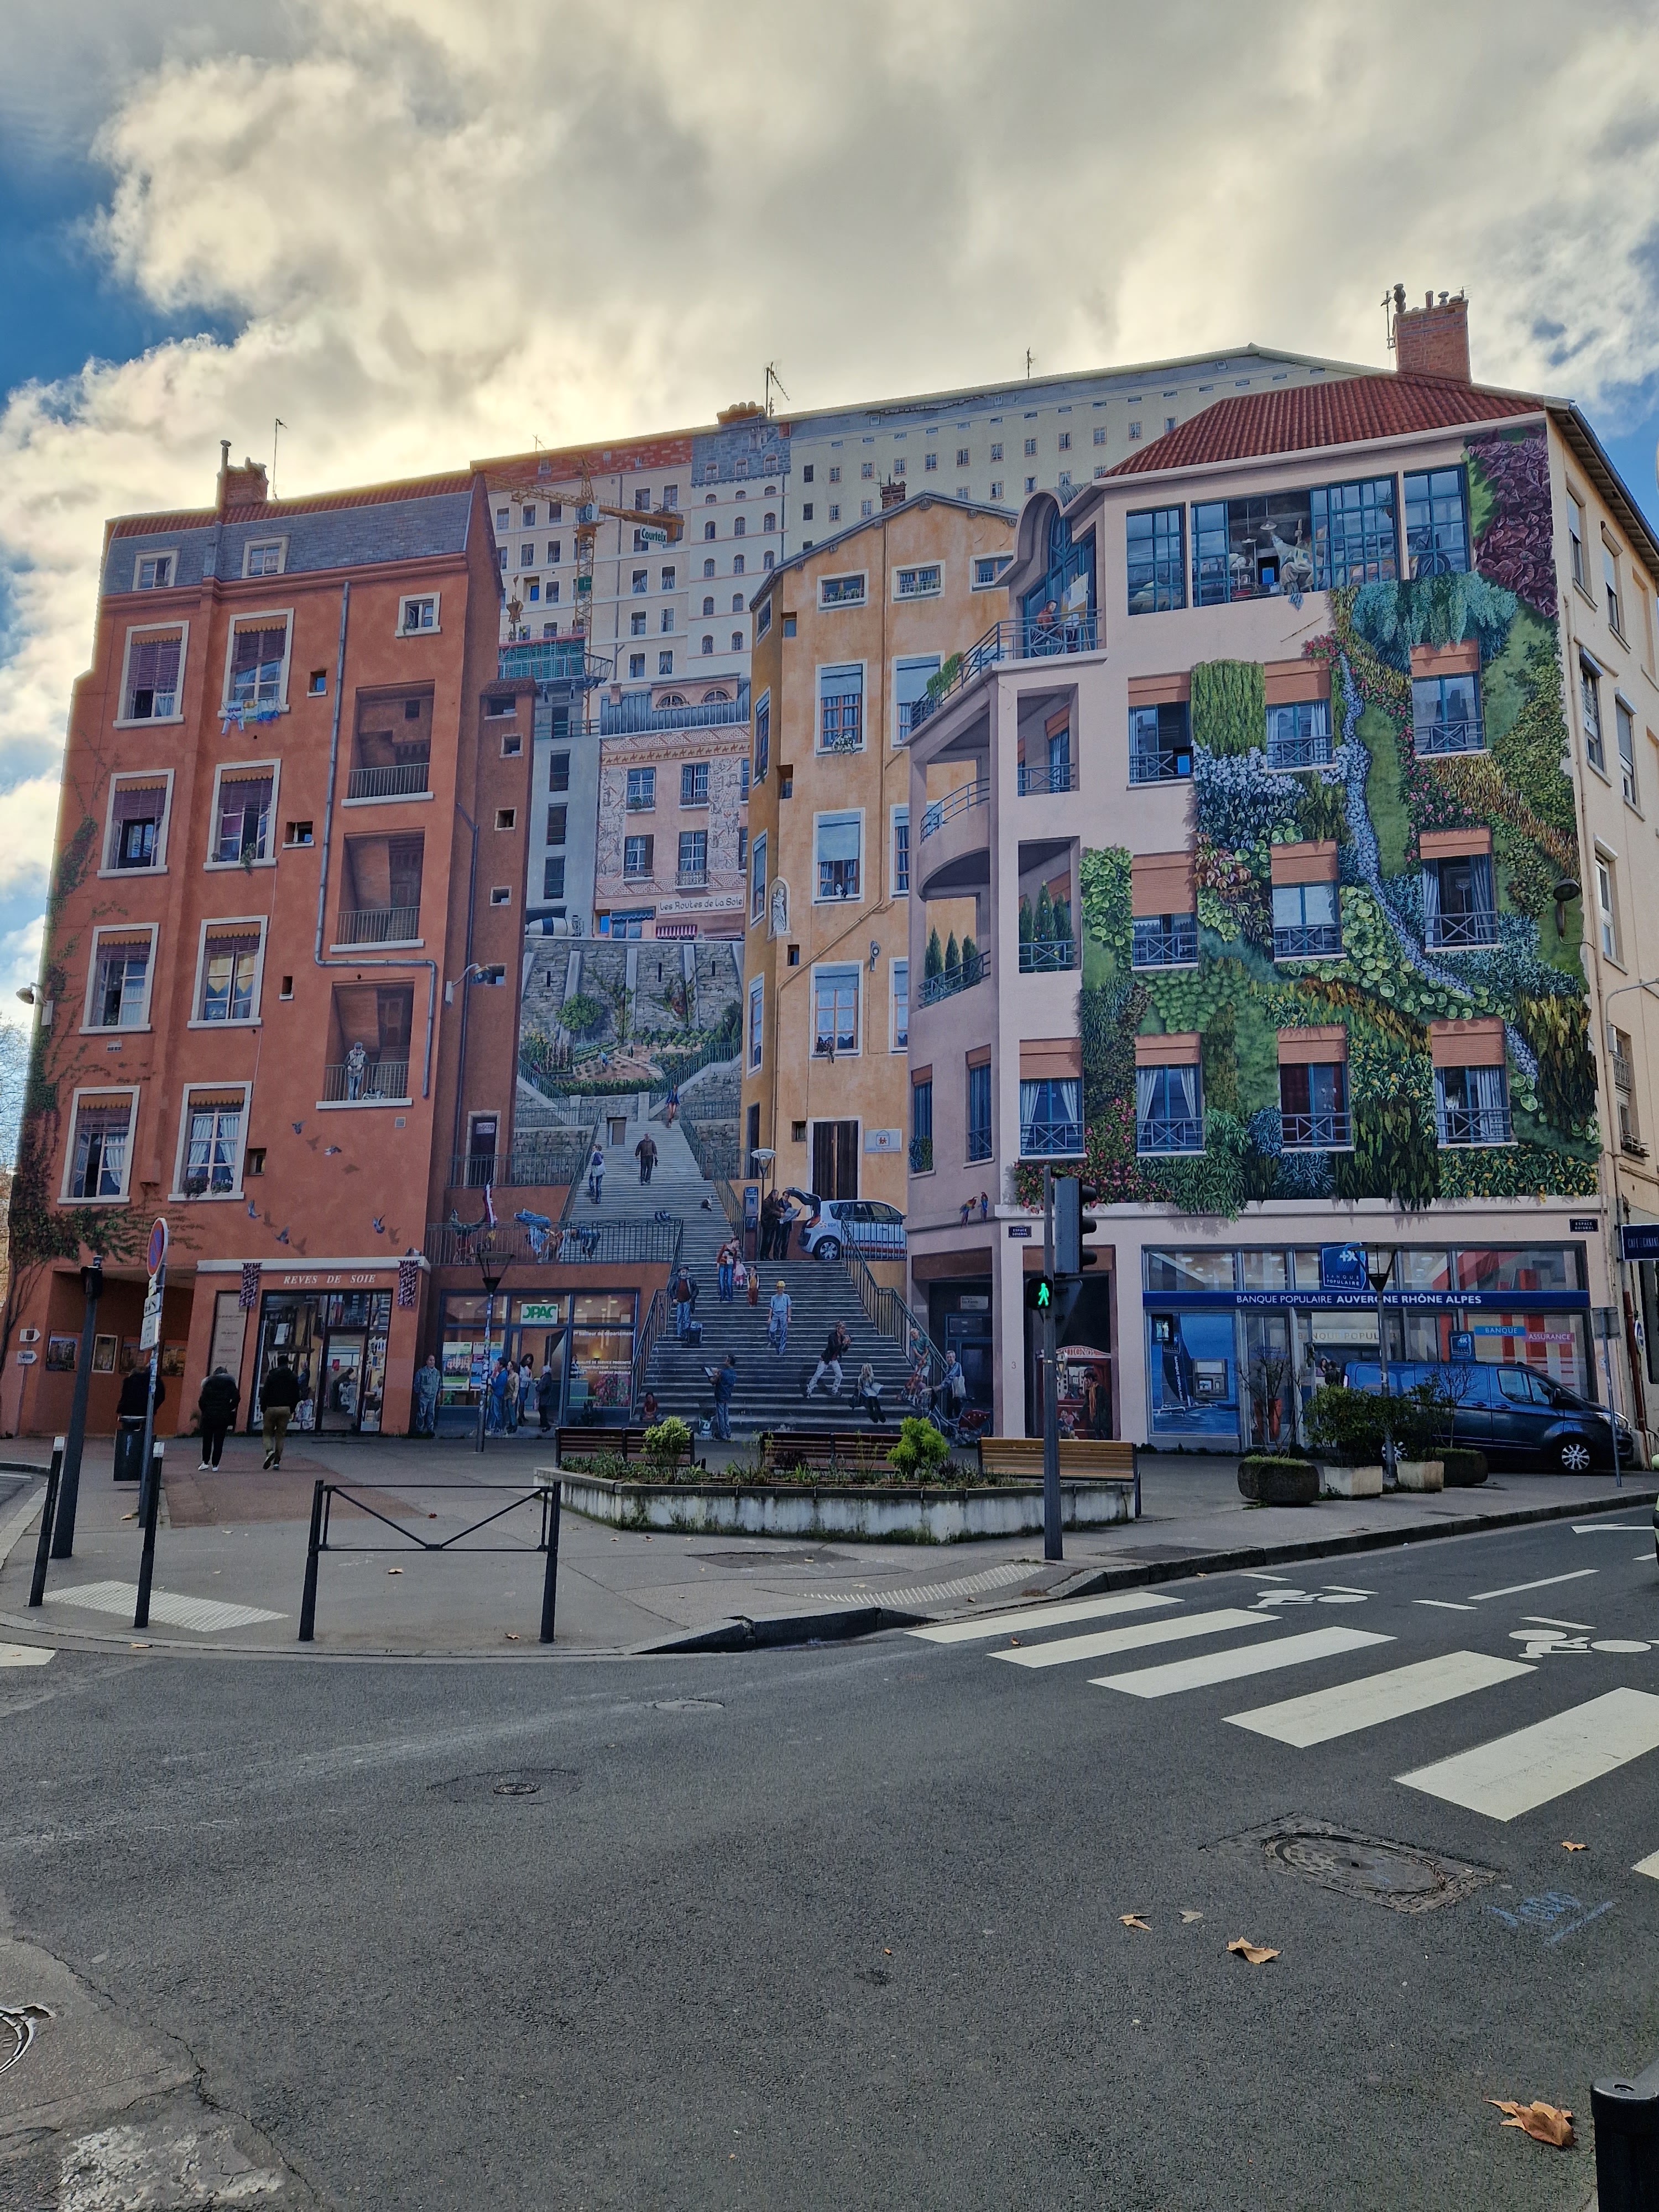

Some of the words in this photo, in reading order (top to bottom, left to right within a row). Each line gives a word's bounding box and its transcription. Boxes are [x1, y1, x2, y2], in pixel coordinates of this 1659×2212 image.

[641, 528, 666, 542] Courteix
[660, 902, 673, 910] Les
[675, 901, 702, 910] Routes
[726, 896, 742, 906] Soie
[283, 1275, 317, 1284] REVES
[326, 1275, 341, 1284] DE
[350, 1274, 376, 1284] SOIE
[1237, 1295, 1277, 1305] BANQUE
[1280, 1295, 1332, 1304] POPULAIRE
[1401, 1293, 1443, 1304] RHÔNE
[1446, 1295, 1482, 1304] ALPES
[523, 1306, 557, 1319] OPAC
[1011, 1361, 1016, 1369] 3
